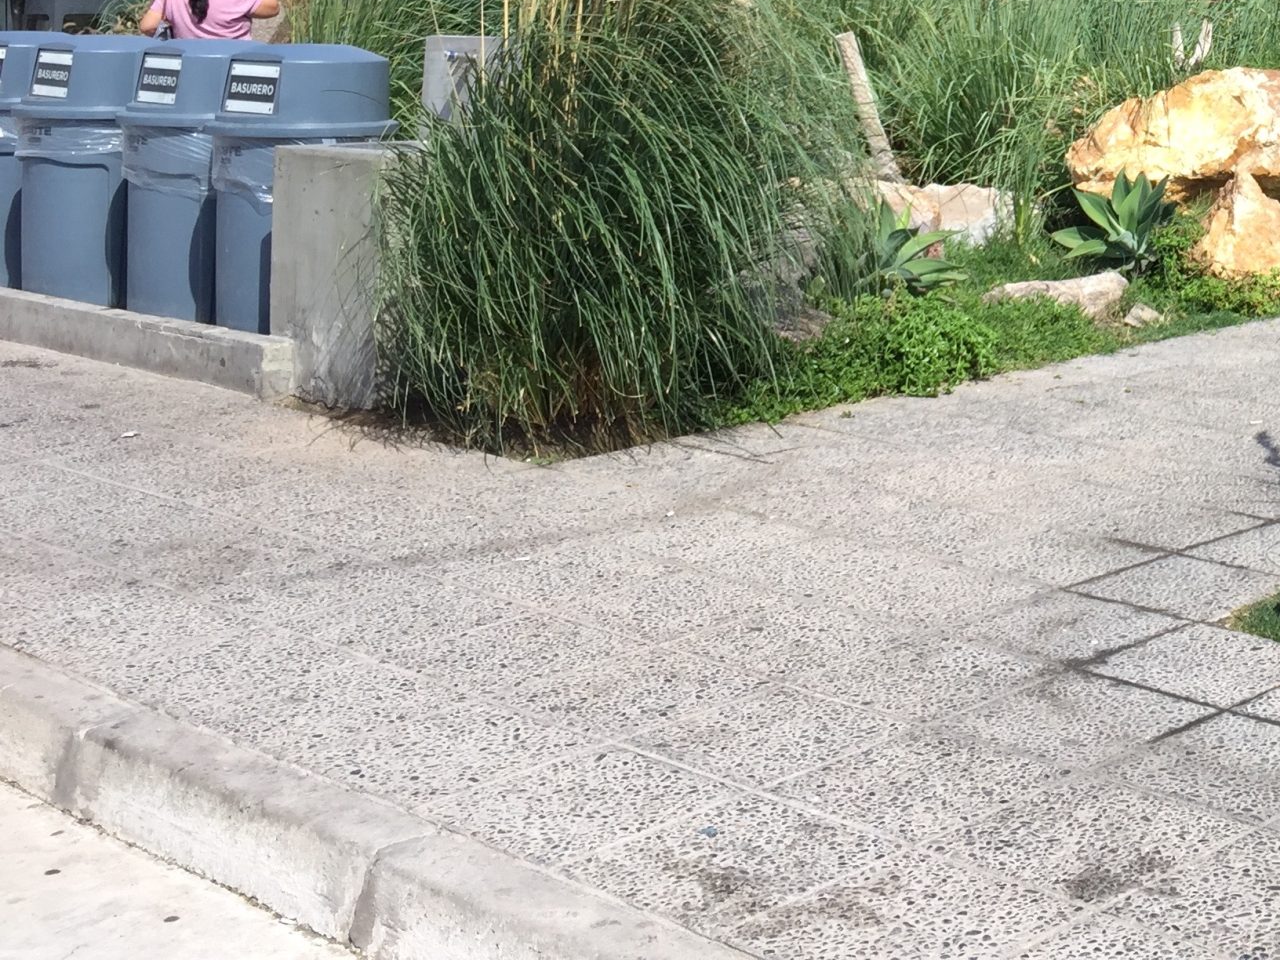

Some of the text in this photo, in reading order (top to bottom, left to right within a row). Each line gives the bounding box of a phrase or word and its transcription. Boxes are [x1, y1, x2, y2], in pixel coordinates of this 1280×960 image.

[37, 69, 69, 81] BASURERO
[142, 74, 177, 87] BASURERO
[230, 82, 274, 96] BASURERO
